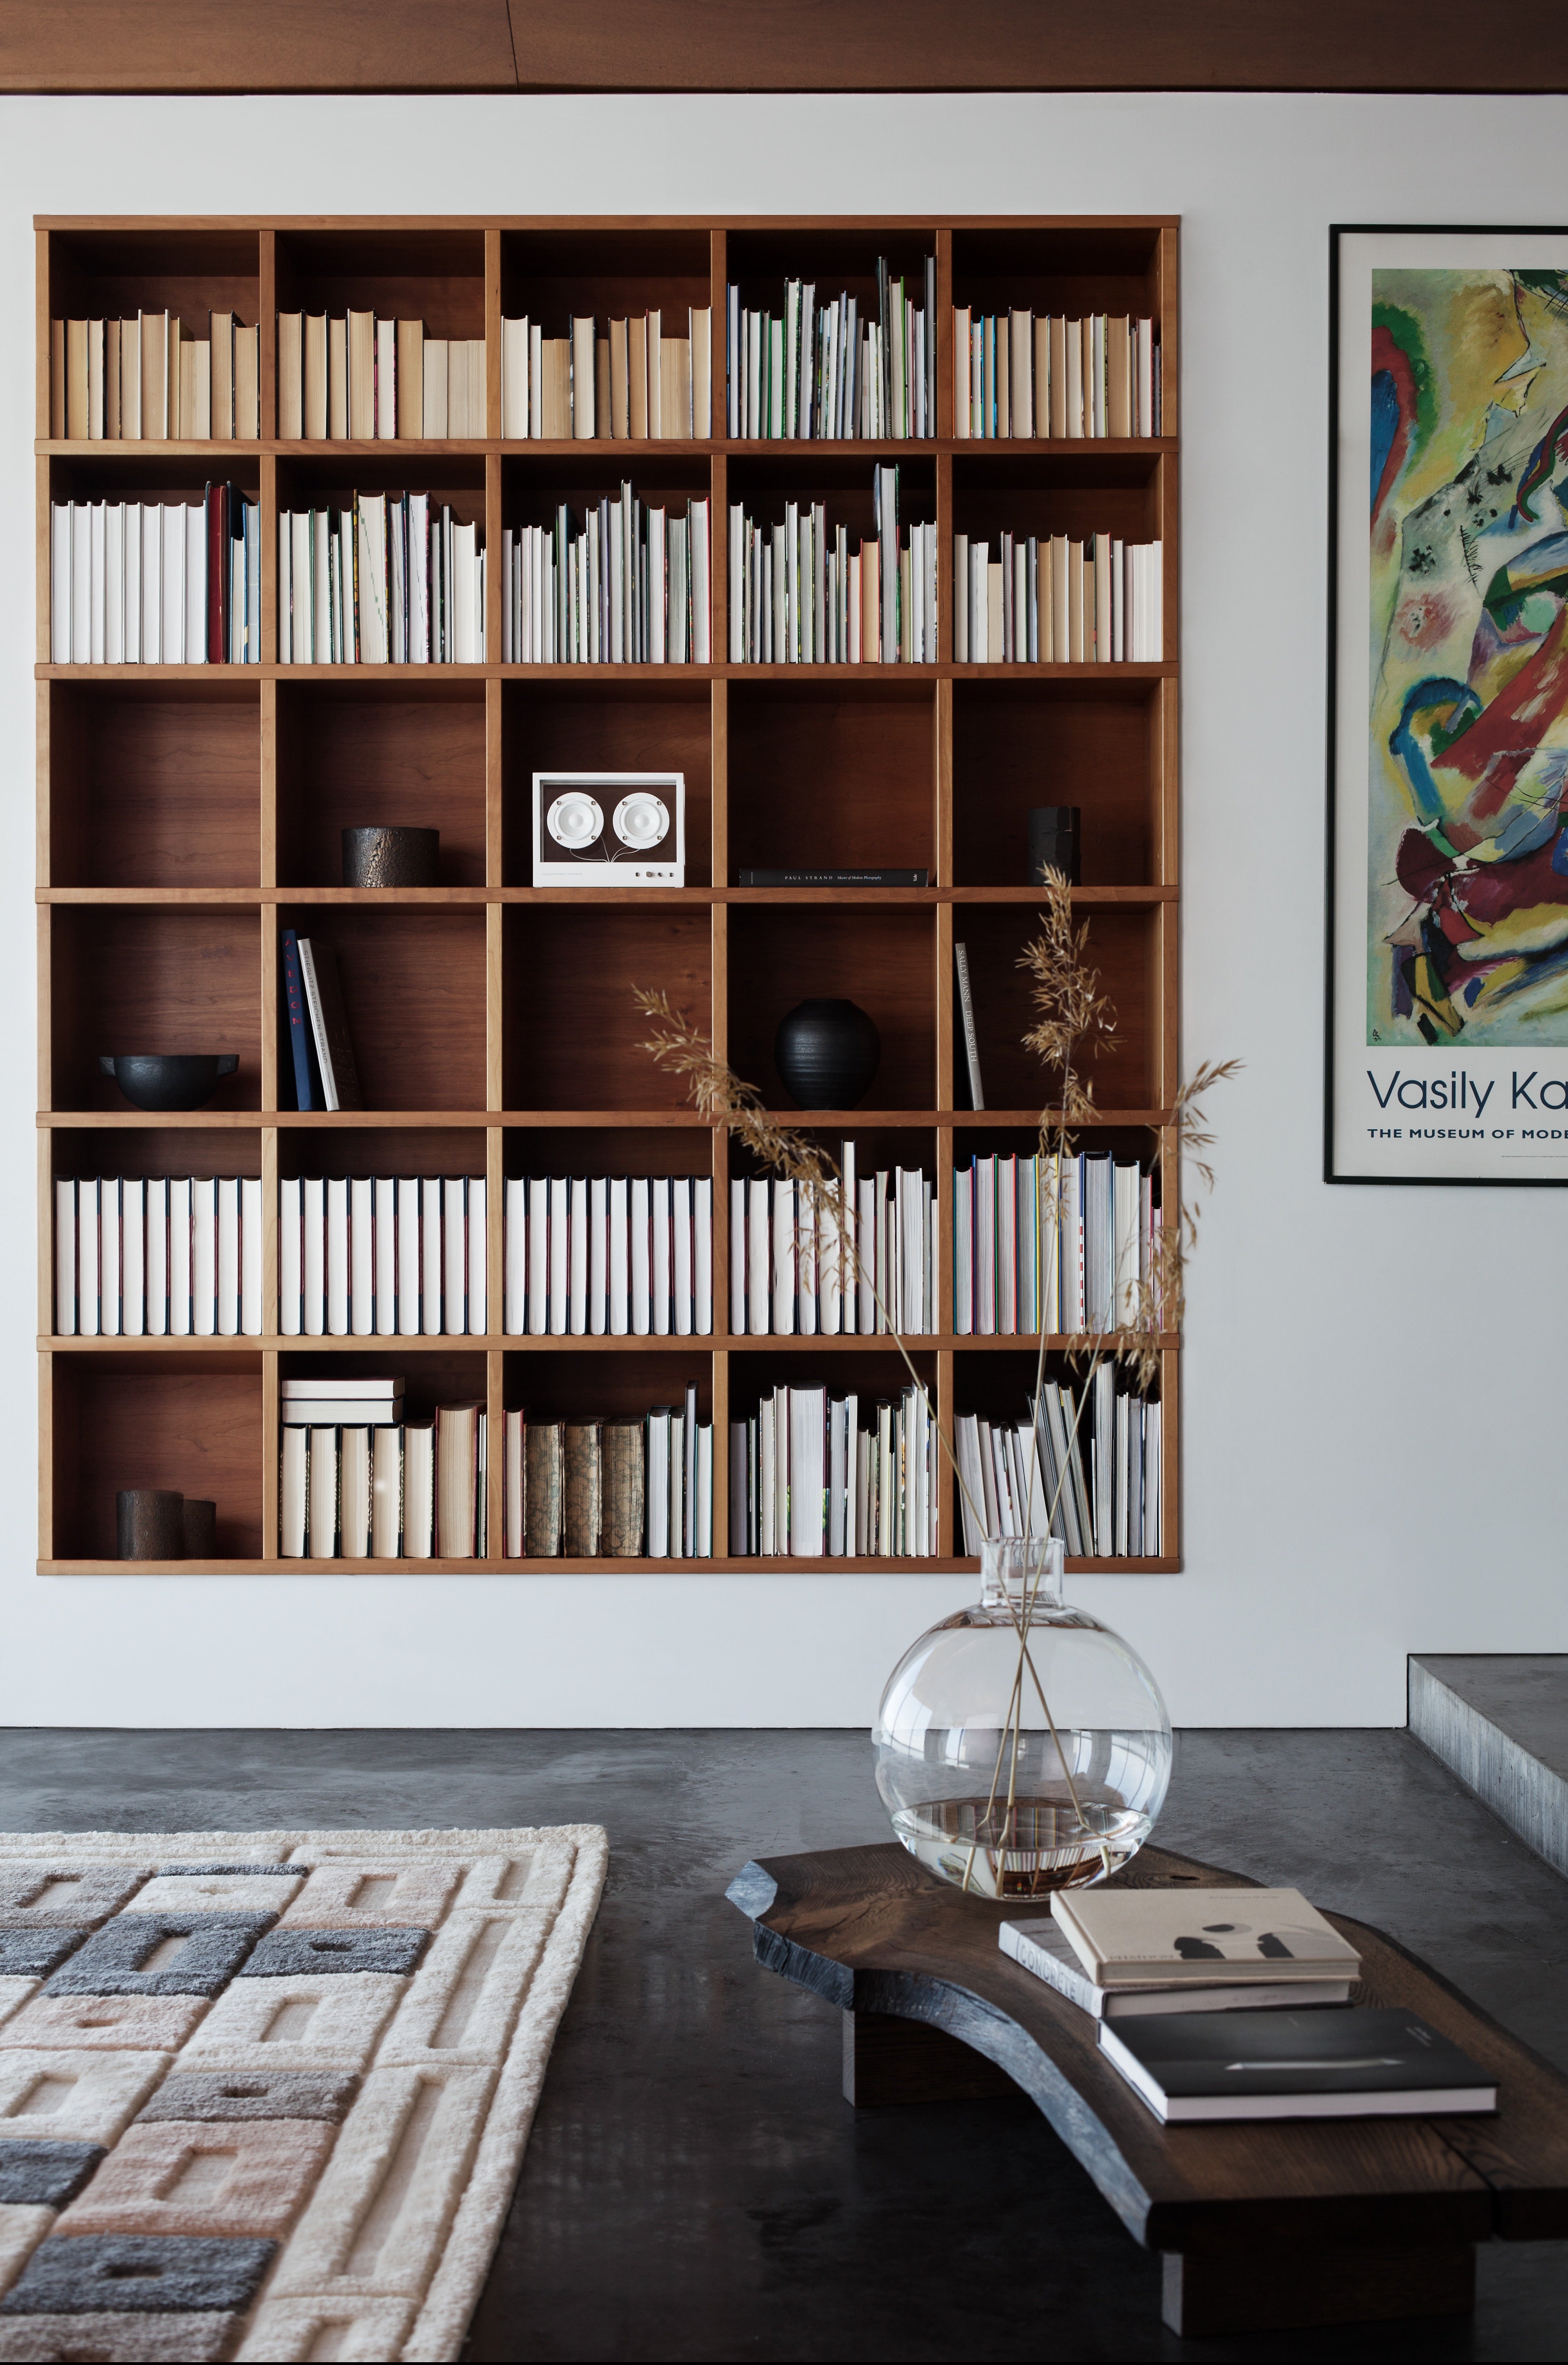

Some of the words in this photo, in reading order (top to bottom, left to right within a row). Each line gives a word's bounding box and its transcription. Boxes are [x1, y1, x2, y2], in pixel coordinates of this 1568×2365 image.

[958, 950, 967, 974] SALLY
[285, 939, 301, 1024] AVEDON
[961, 977, 970, 1002] MANN
[303, 950, 314, 989] STIEGLITZ
[310, 991, 321, 1030] STEICHEN
[318, 1032, 328, 1064] STRAND
[968, 1033, 977, 1062] SOUTH
[1366, 1070, 1495, 1118] Vasily
[1512, 1071, 1568, 1110] Ka
[1367, 1129, 1402, 1138] THE
[1410, 1129, 1484, 1139] MUSEUM
[1492, 1130, 1514, 1139] OF
[1020, 1944, 1076, 2000] CONCRETE
